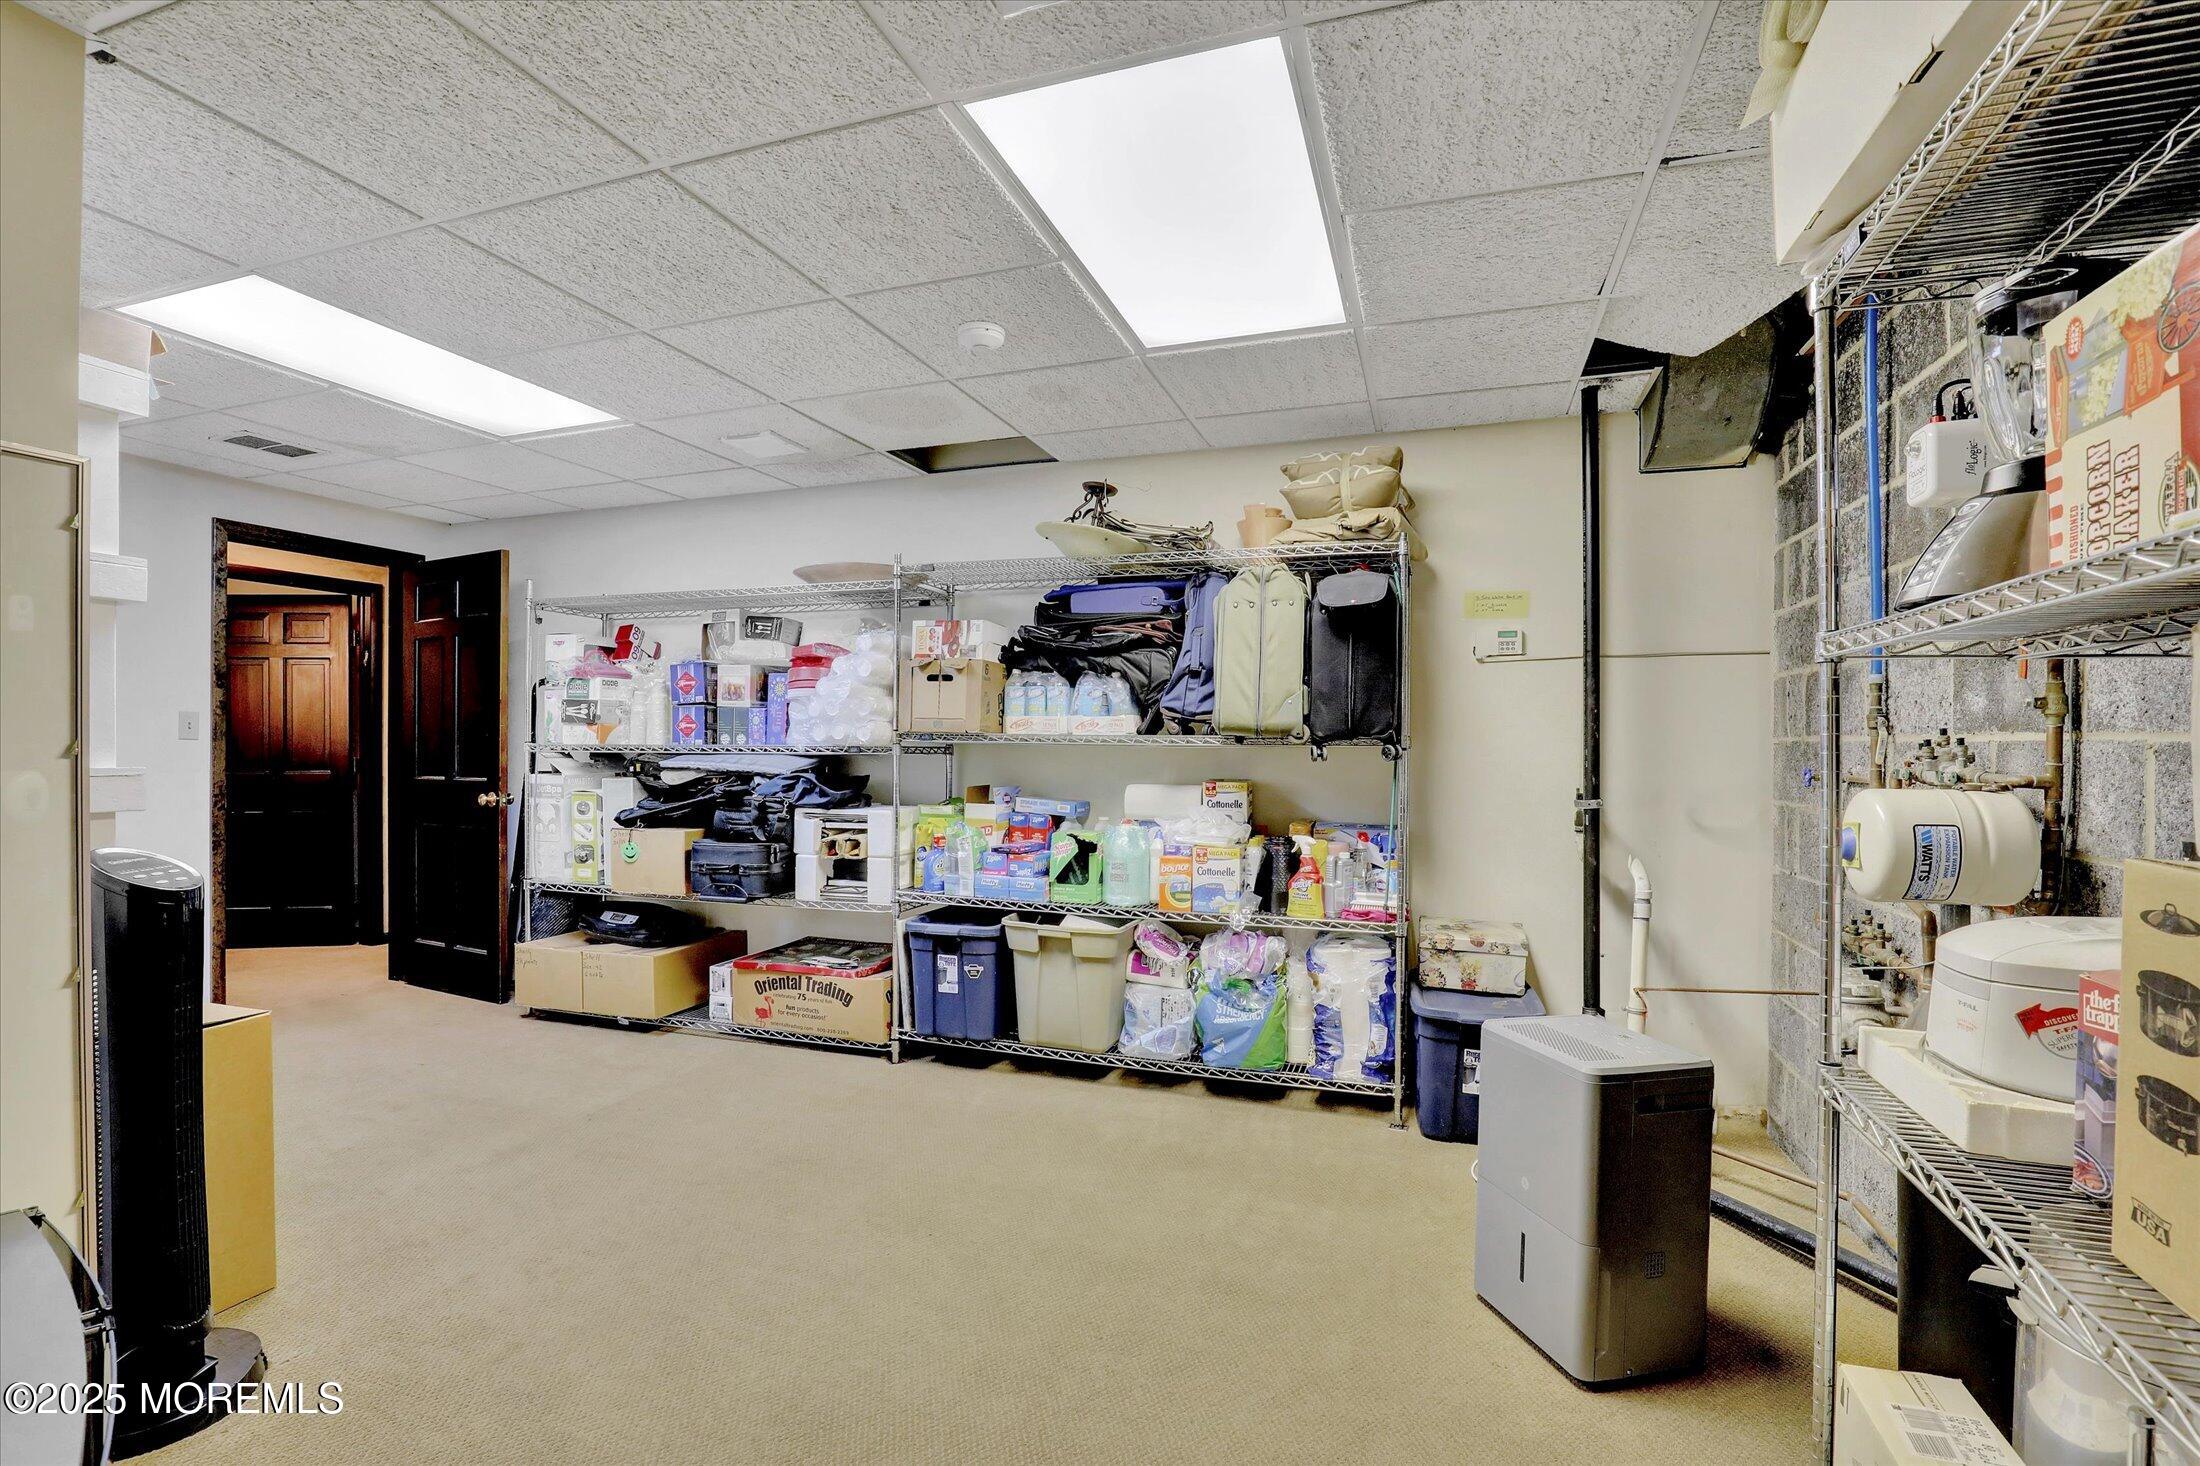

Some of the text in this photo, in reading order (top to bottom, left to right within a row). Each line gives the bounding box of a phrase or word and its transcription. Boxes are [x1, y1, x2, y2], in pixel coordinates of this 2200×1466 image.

[2087, 439, 2110, 557] OPCORN
[2114, 444, 2140, 550] AKER
[1206, 799, 1243, 809] Cottonelle
[1918, 844, 1933, 882] WATTS
[1942, 829, 1951, 879] EXPANSION TANK
[1950, 829, 1958, 878] POTABLE WATER
[1197, 866, 1236, 877] Cottonelle
[754, 975, 802, 995] Oriental
[805, 976, 854, 1008] Trading
[797, 993, 807, 1001] 75
[2089, 989, 2112, 1009] the
[796, 1005, 819, 1014] products
[2053, 1025, 2078, 1035] T-FA
[2136, 1209, 2167, 1245] USA
